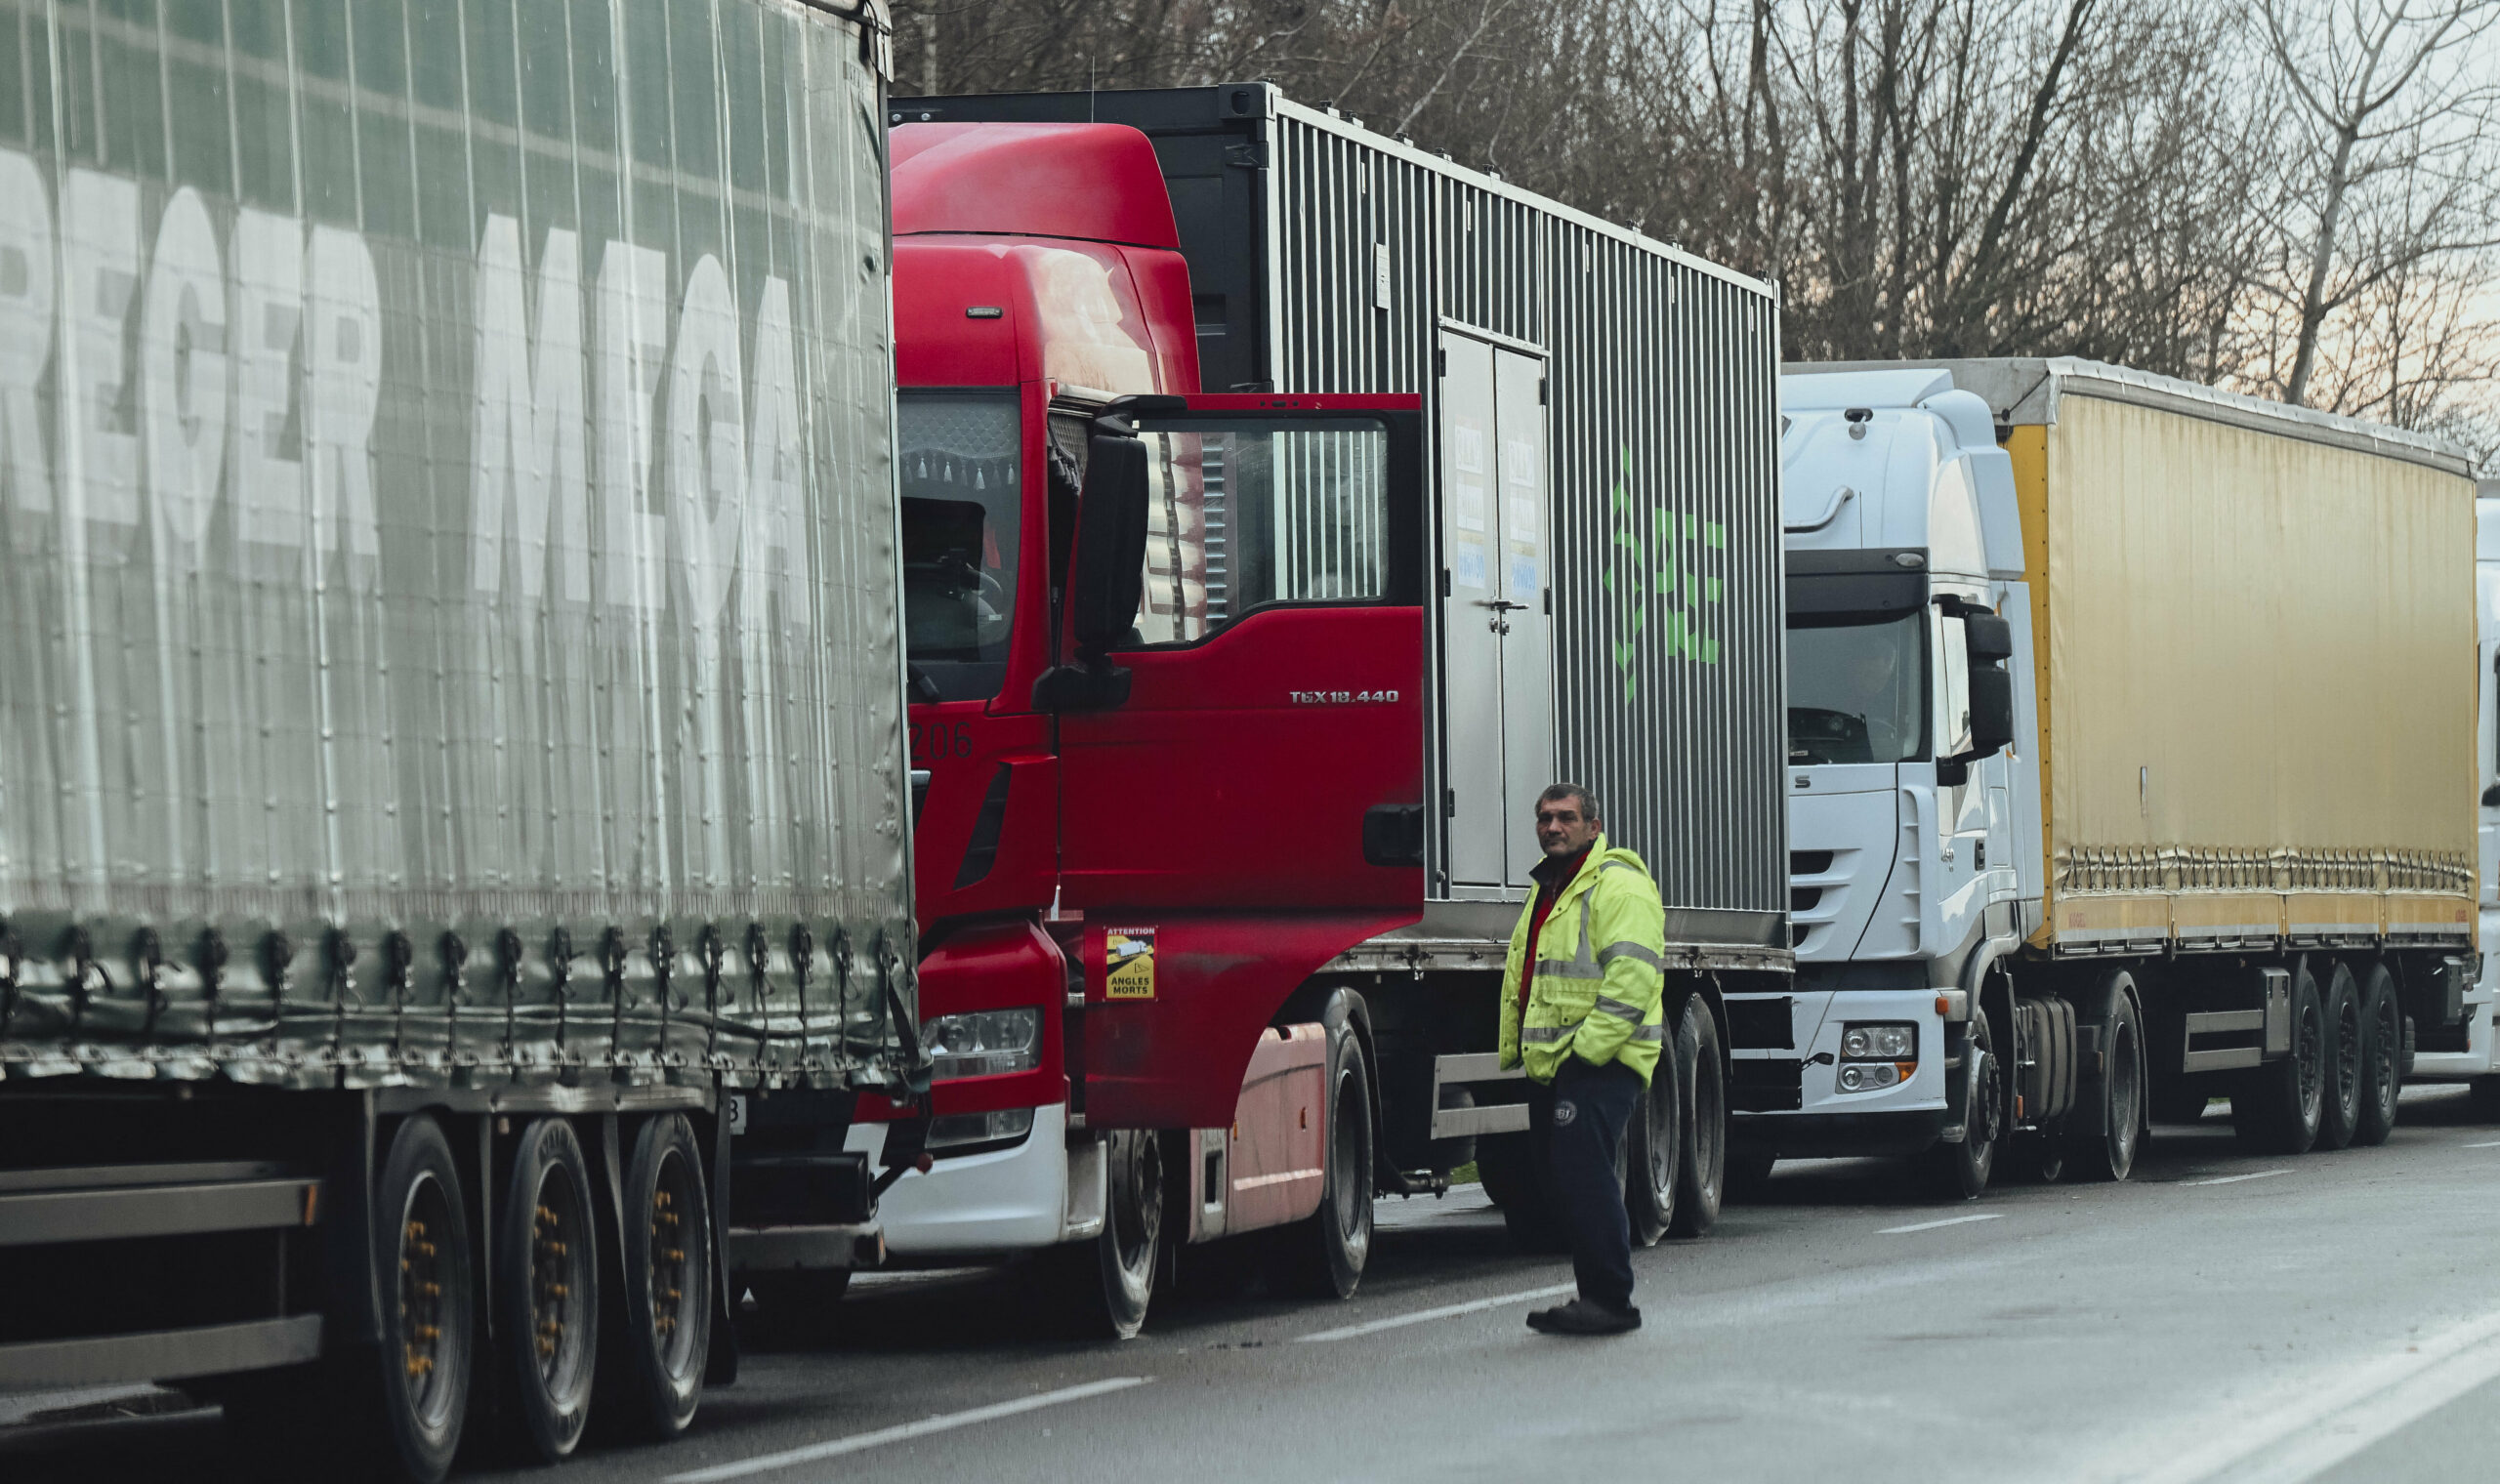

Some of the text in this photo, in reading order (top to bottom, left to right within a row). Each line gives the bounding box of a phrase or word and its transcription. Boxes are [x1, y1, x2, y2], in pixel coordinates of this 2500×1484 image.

[474, 212, 811, 626] MEGA
[1330, 690, 1399, 703] 18.440
[1111, 977, 1149, 986] ANGLES
[1113, 986, 1148, 995] MORTS
